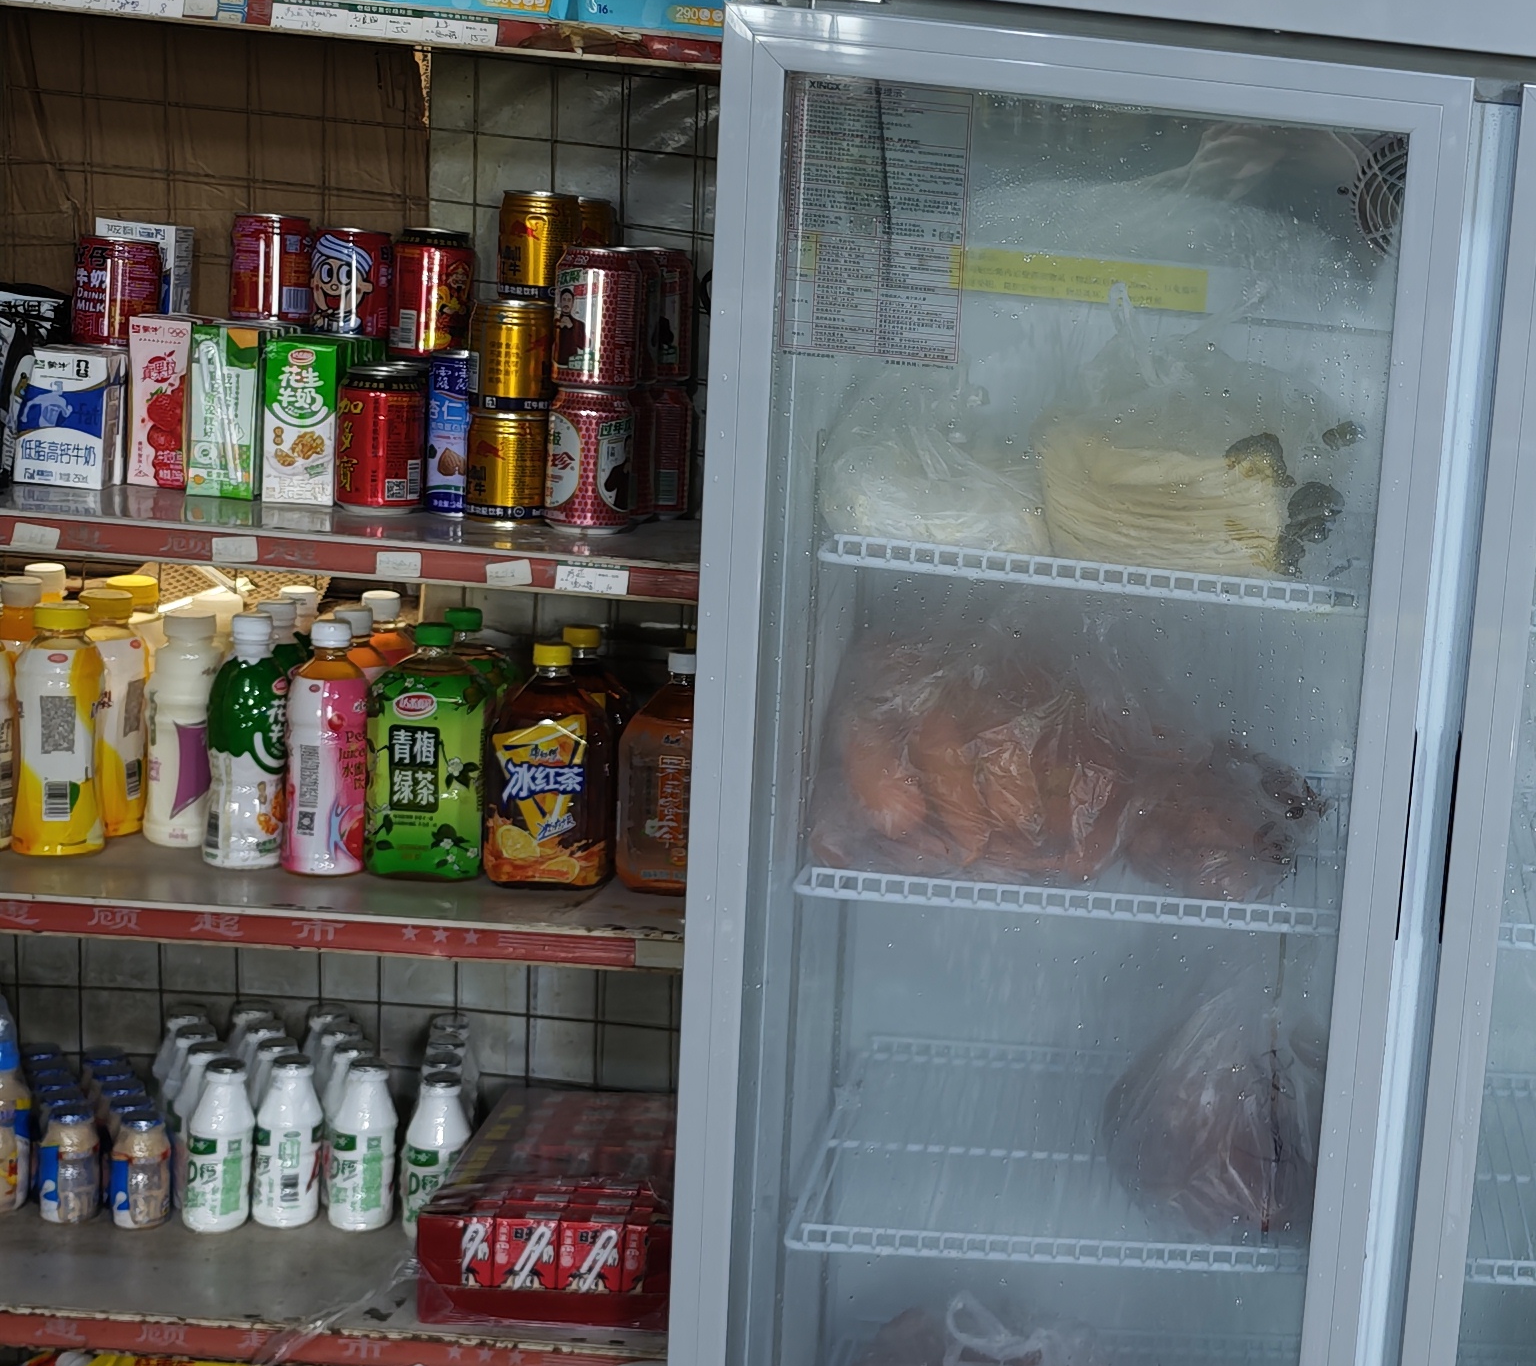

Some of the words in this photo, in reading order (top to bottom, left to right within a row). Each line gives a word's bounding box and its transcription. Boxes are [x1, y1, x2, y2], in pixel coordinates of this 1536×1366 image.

[675, 7, 699, 20] 290
[77, 300, 105, 314] MILK
[279, 365, 324, 388] 花生
[277, 388, 323, 410] 牛奶
[21, 437, 97, 467] 低脂高钙牛奶
[391, 728, 436, 765] 青梅
[392, 768, 436, 806] 绿茶
[502, 759, 584, 802] 冰红茶
